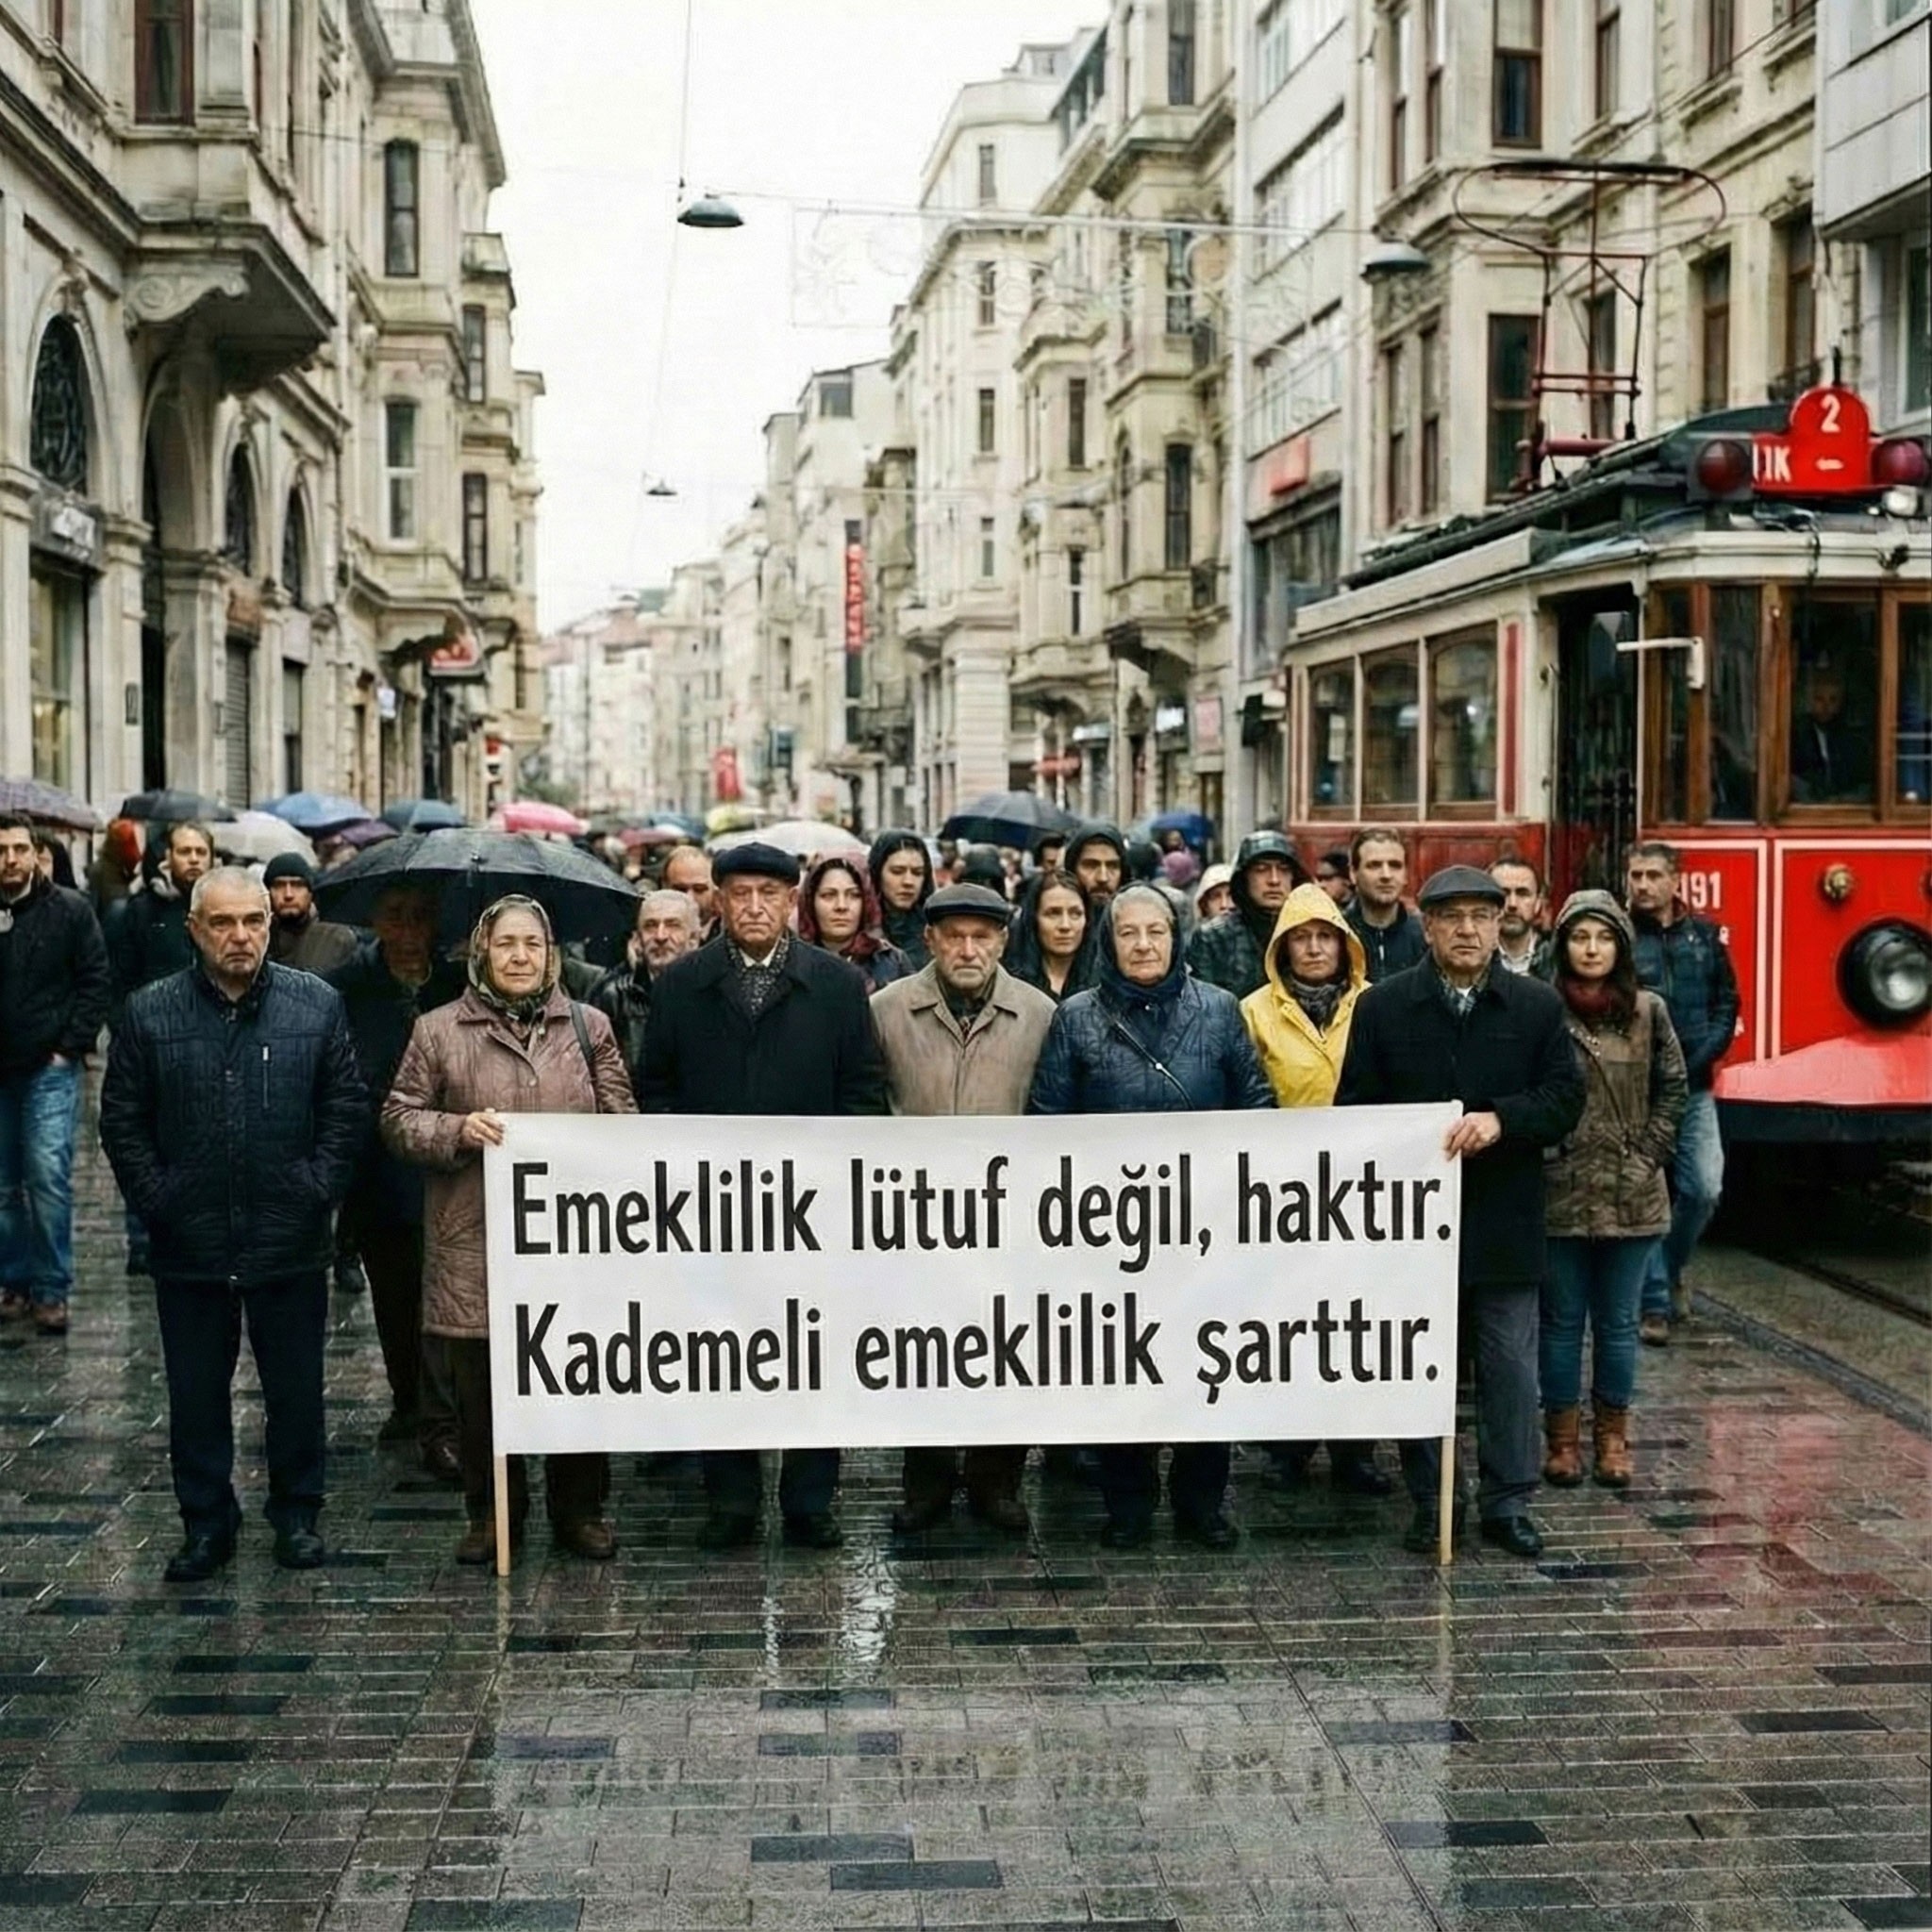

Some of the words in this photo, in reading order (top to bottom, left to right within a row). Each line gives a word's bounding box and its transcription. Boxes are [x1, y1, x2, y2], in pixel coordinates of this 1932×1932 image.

[1821, 393, 1840, 433] 2
[512, 1158, 822, 1255] Emeklilik
[851, 1156, 1008, 1252] lütuf
[1038, 1154, 1211, 1274] değil,
[1238, 1151, 1451, 1244] haktır.
[515, 1298, 821, 1396] Kademeli
[855, 1291, 1164, 1391] emeklilik
[1196, 1298, 1438, 1405] şarttır.
